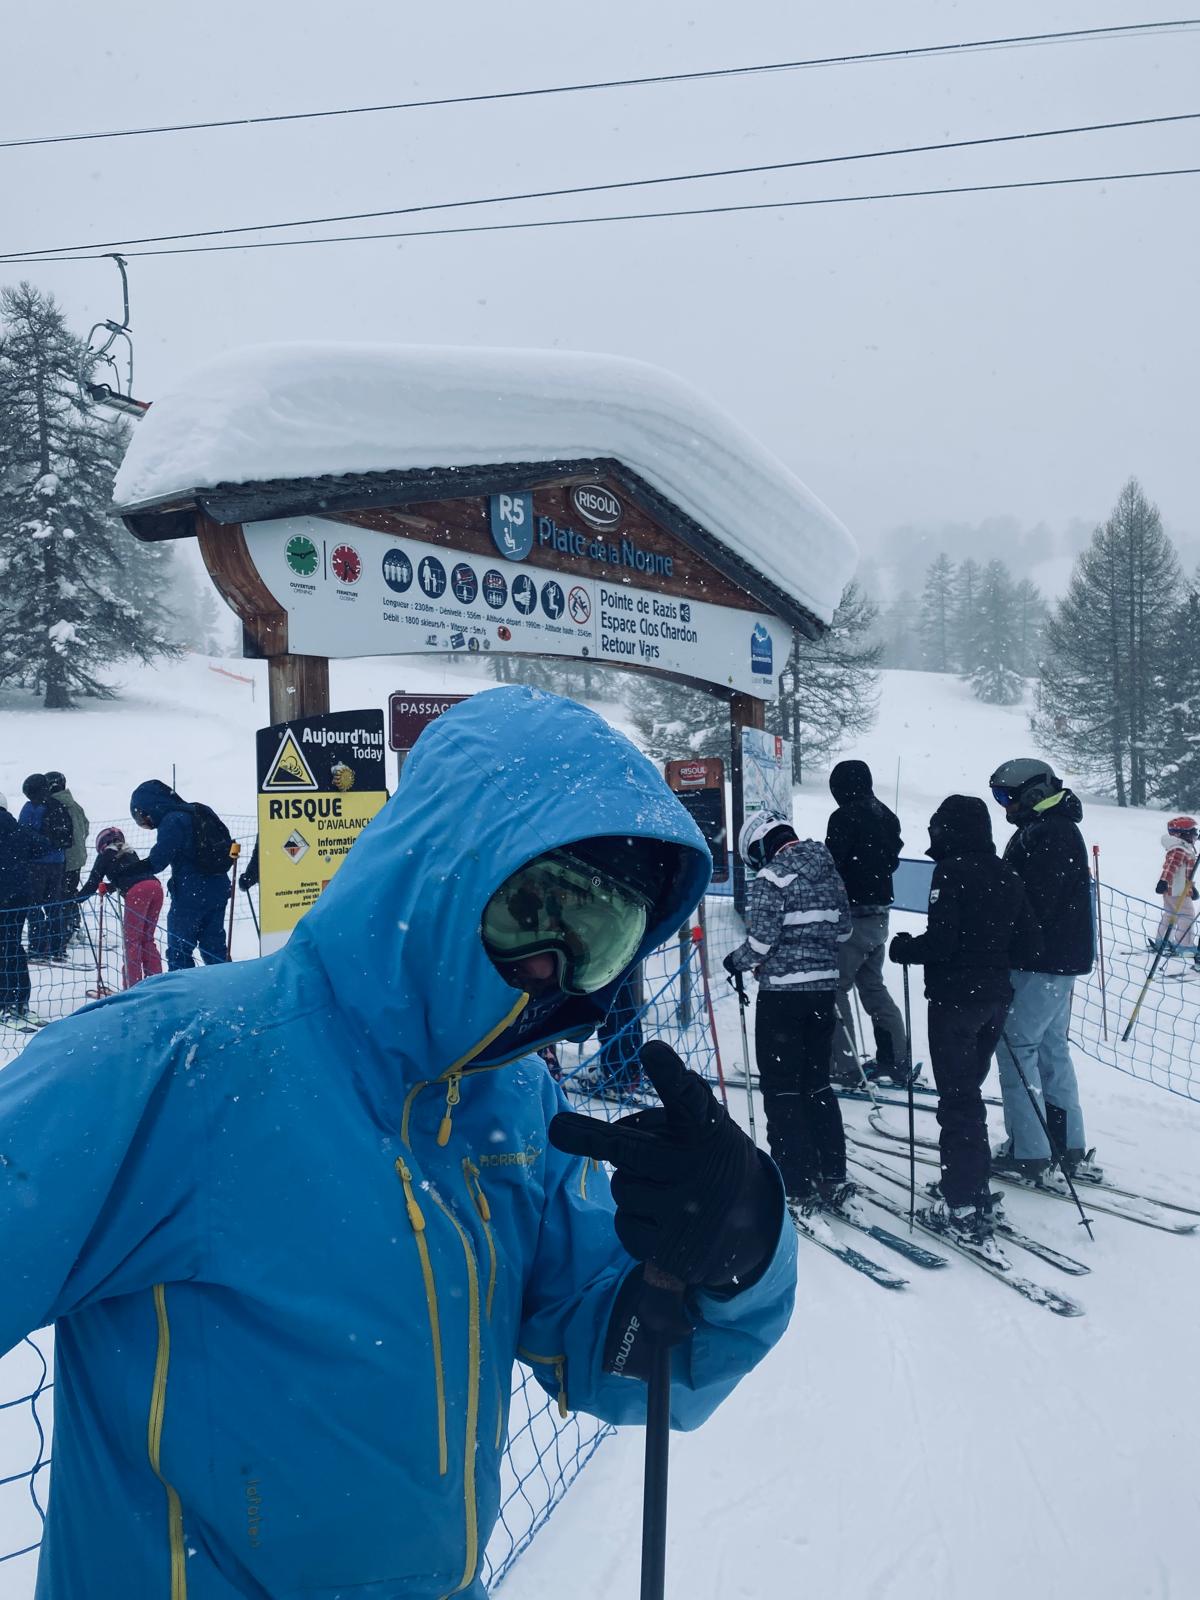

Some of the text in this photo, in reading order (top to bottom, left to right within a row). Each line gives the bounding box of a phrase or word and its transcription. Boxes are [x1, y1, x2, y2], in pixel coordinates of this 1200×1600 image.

[500, 494, 525, 525] R5
[579, 491, 618, 516] RISOUL
[538, 516, 673, 577] Plate de la Nonne
[383, 597, 409, 609] Longueur
[415, 602, 434, 612] 2308m
[600, 589, 677, 619] Pointe de Razis
[383, 612, 399, 623] Débit
[405, 616, 419, 625] 1800
[601, 610, 697, 643] Espace Clos Chardon
[601, 634, 660, 659] Retour Vars
[302, 727, 383, 747] Aujourd'hui
[352, 746, 383, 762] Today
[680, 766, 705, 775] RISOUL
[269, 798, 342, 822] RISQUE
[318, 846, 351, 856] on avala
